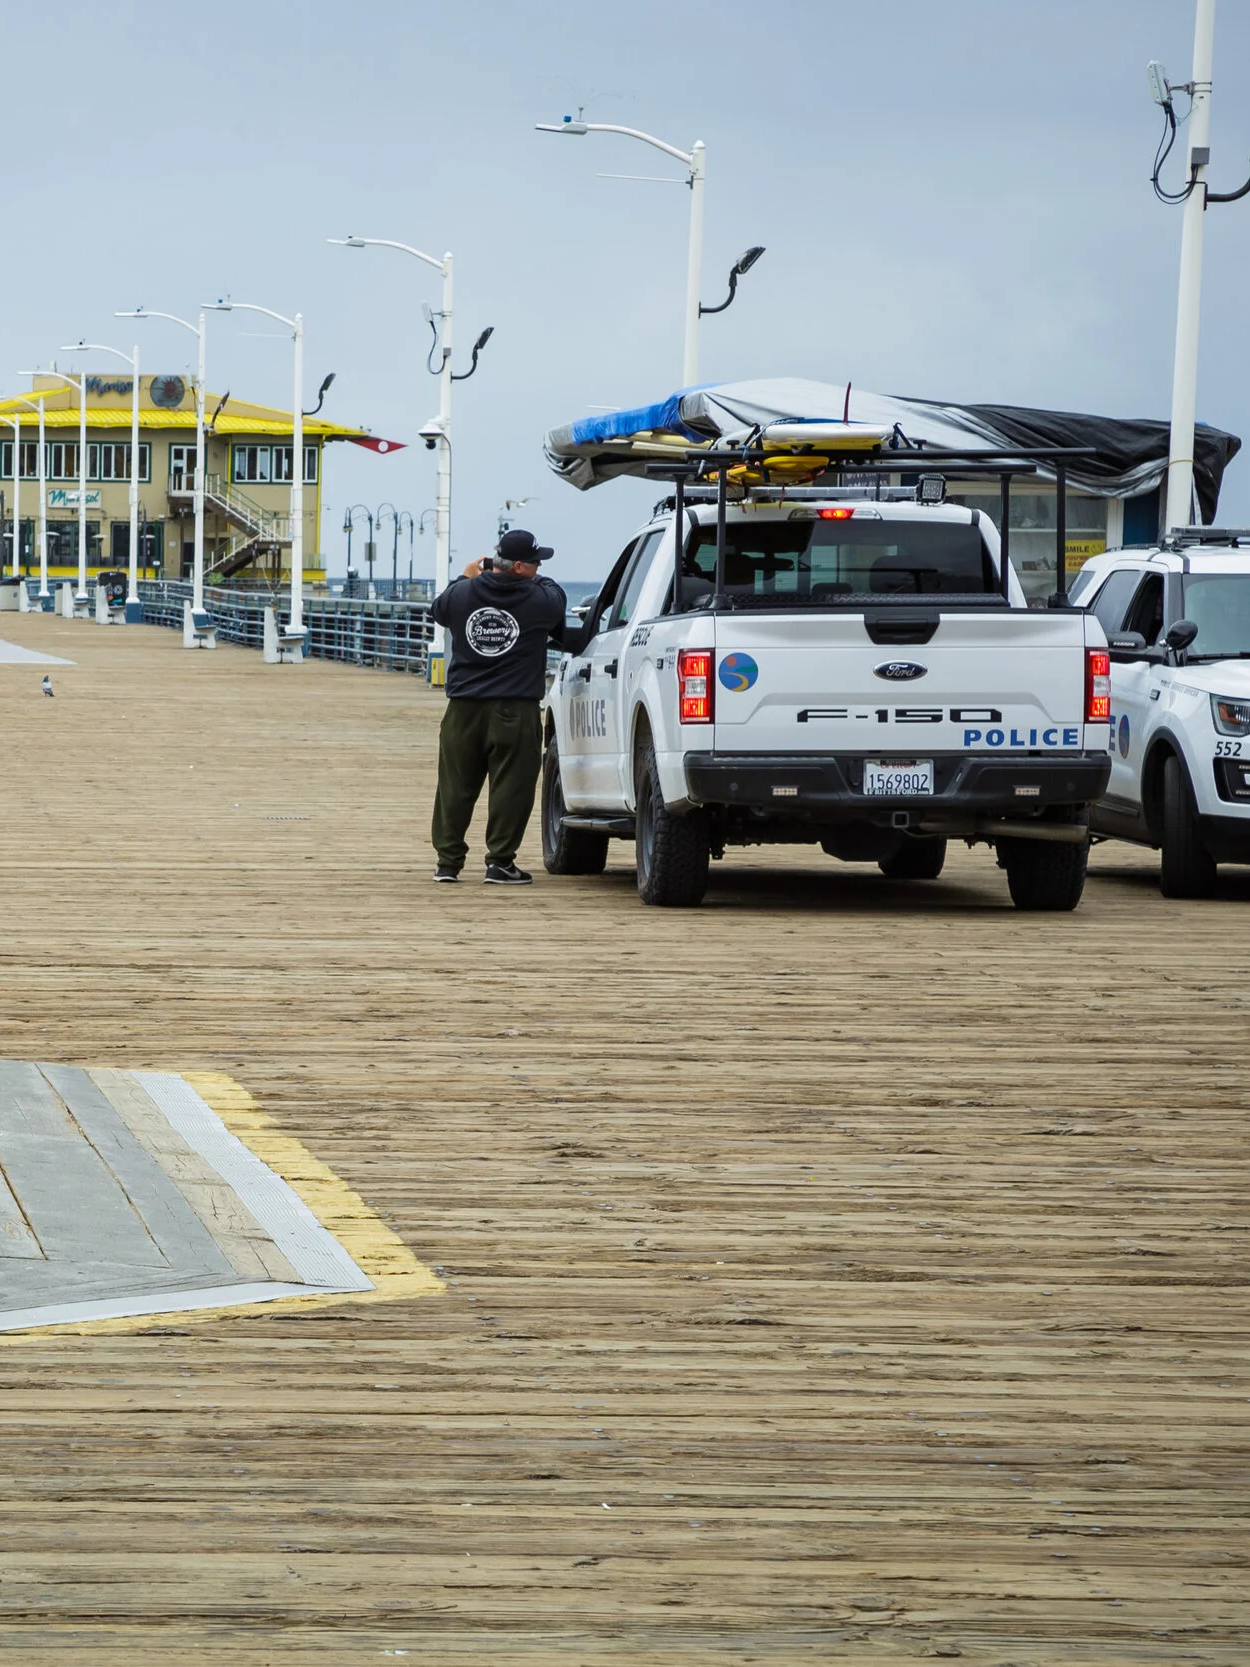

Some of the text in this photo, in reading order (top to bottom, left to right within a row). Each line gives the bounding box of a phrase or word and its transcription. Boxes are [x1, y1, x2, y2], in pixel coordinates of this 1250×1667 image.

[472, 625, 510, 636] Brewery
[886, 663, 915, 678] Ford
[576, 699, 606, 738] POLICE
[797, 708, 1002, 723] F-150
[963, 728, 1079, 746] POLICE
[1215, 741, 1242, 756] 552
[870, 773, 928, 790] 1569802
